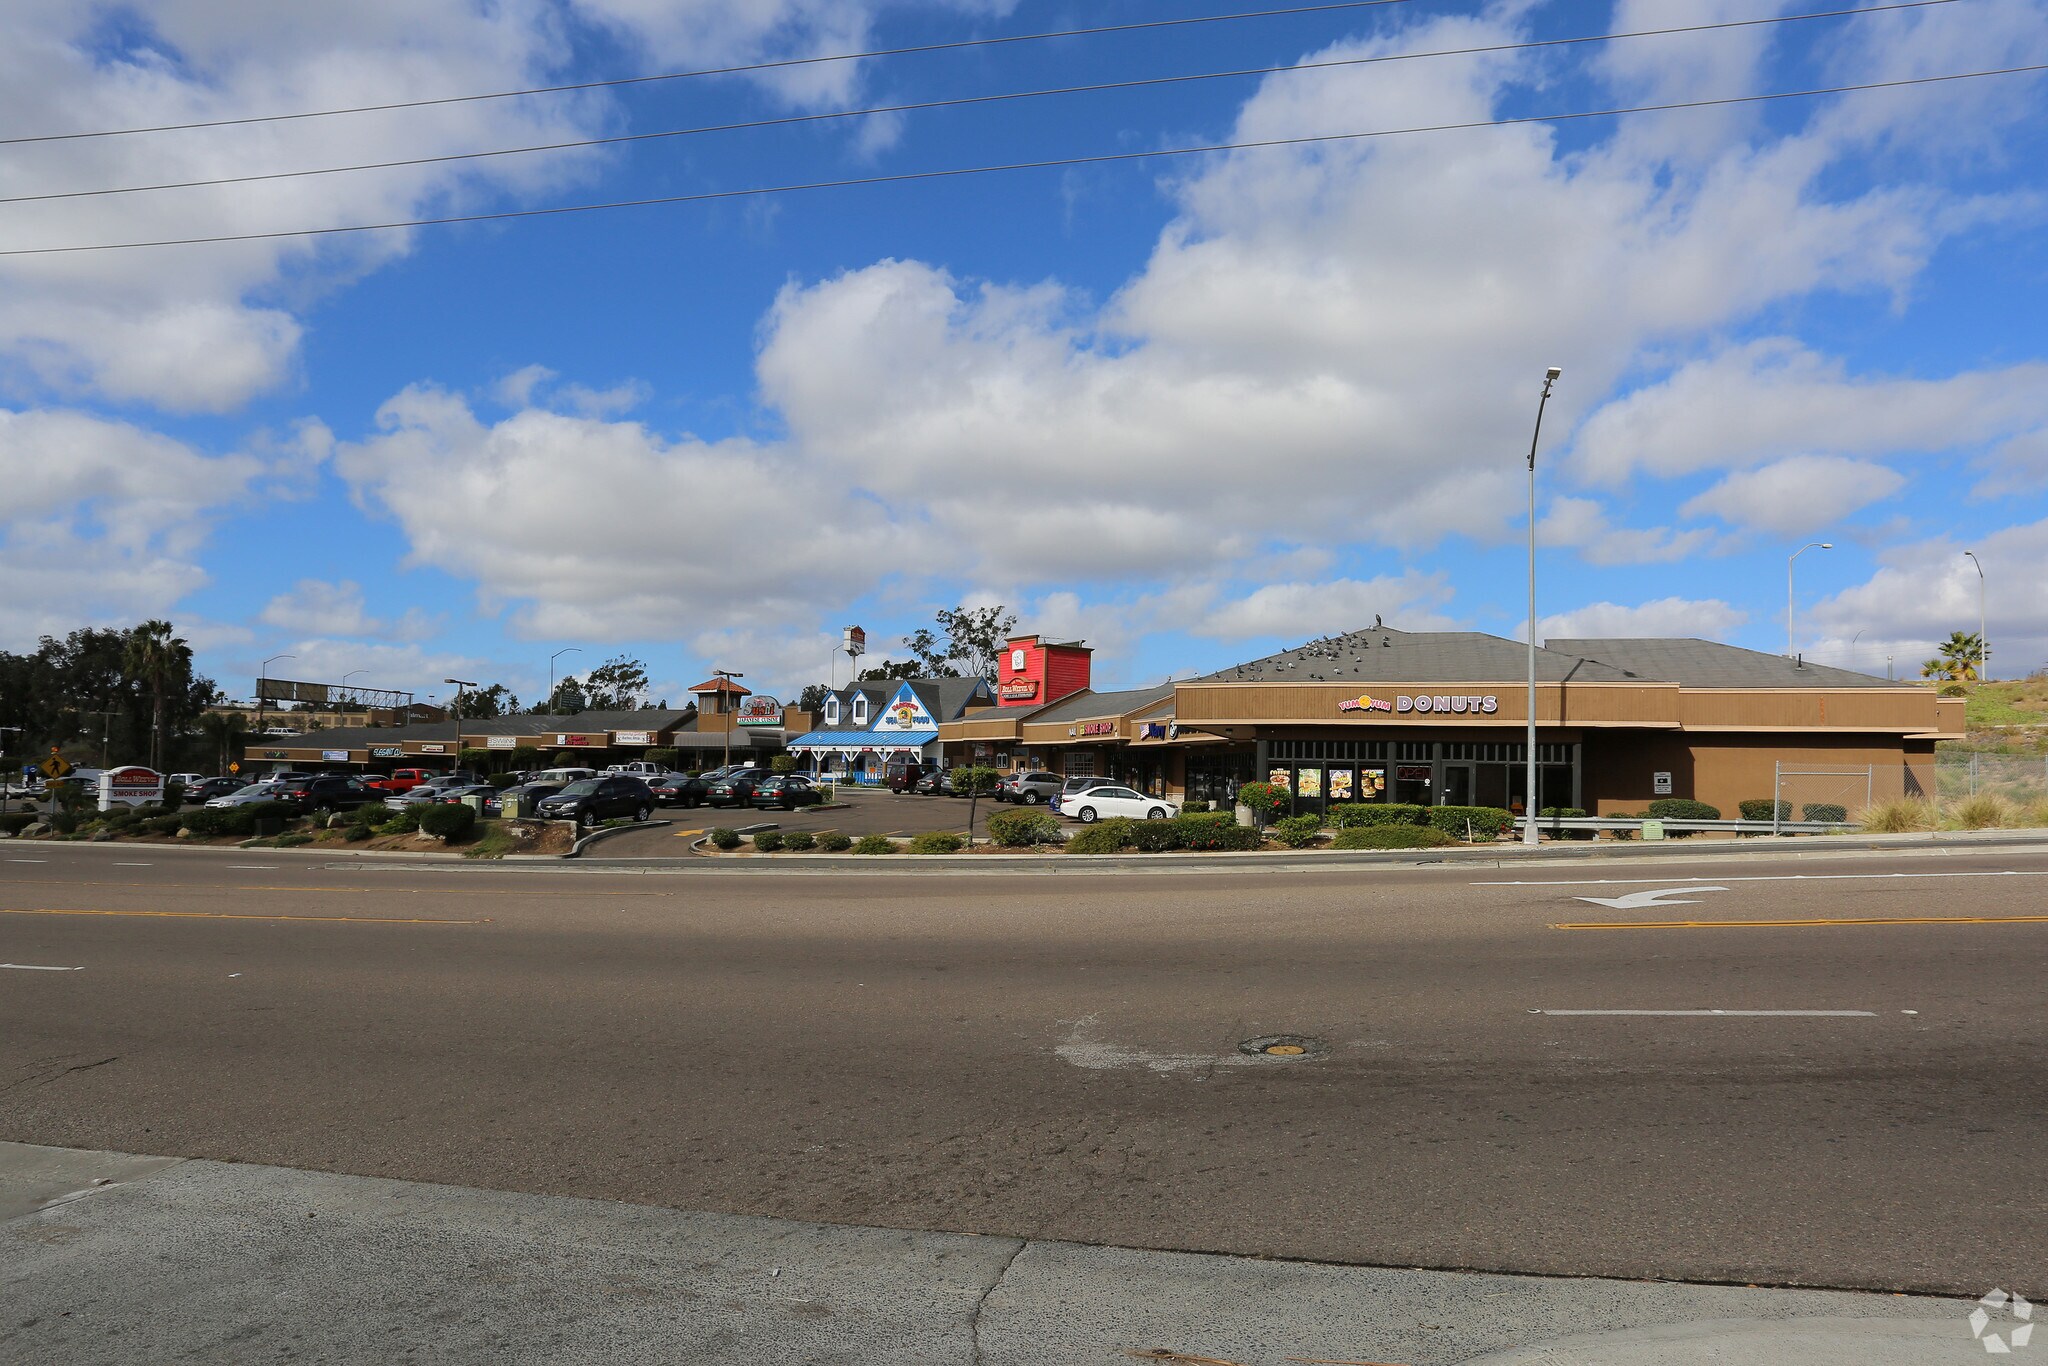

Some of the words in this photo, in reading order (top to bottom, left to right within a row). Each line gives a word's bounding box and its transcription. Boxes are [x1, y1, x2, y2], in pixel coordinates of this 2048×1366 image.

[744, 703, 776, 716] Sushi
[1338, 699, 1361, 711] YUM
[1370, 699, 1391, 711] YUM
[1397, 695, 1498, 714] DONUTS
[1085, 724, 1099, 735] SMOKE
[1100, 723, 1112, 734] SHOP
[1399, 768, 1431, 779] OPEN
